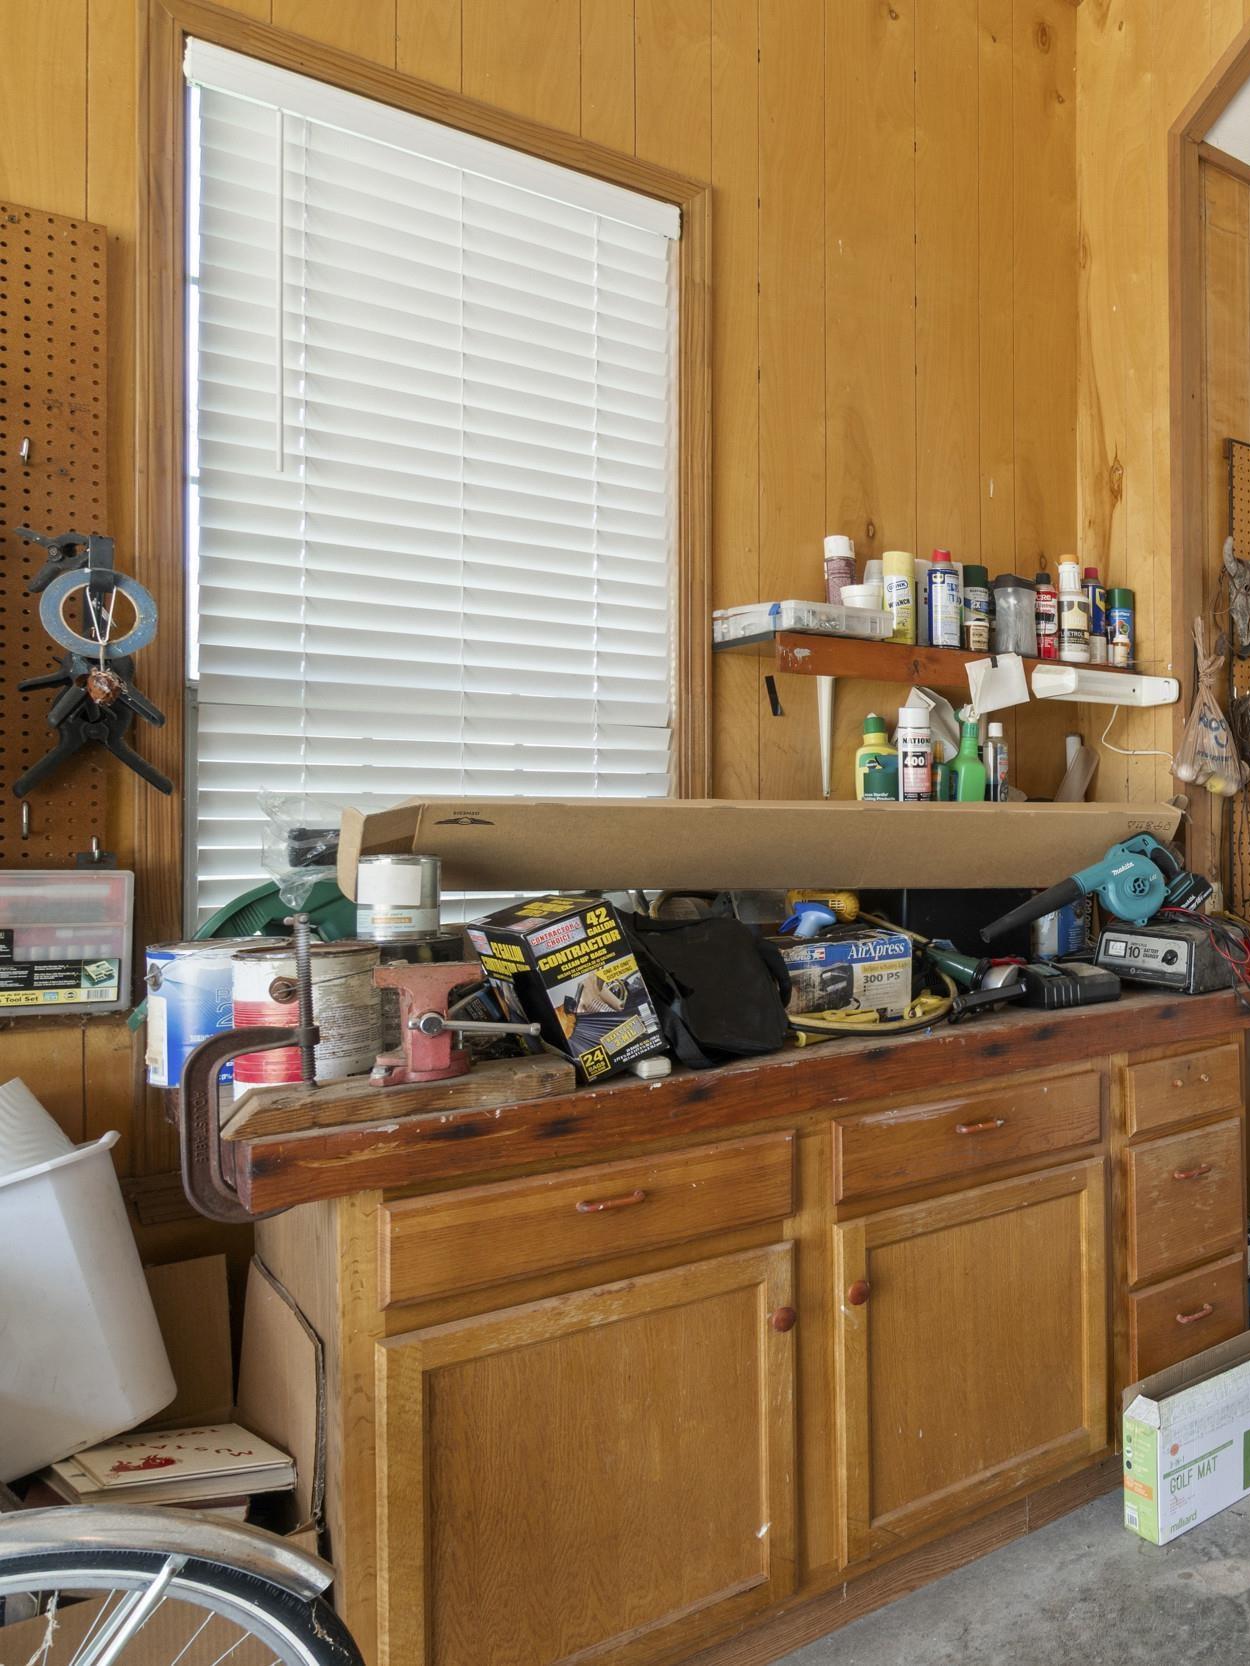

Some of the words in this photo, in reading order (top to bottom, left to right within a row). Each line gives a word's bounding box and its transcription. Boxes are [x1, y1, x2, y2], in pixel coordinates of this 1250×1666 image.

[887, 598, 911, 608] WENCH
[904, 756, 925, 767] 400
[1111, 861, 1135, 876] Makita
[586, 907, 610, 925] 42
[586, 919, 616, 937] GALLON
[537, 929, 621, 972] CONTRACTOR
[847, 941, 905, 961] AirXpress
[1128, 945, 1141, 959] 10
[863, 974, 884, 984] 300
[583, 1049, 604, 1067] 24
[588, 1060, 606, 1073] BAGS
[1169, 1468, 1193, 1494] GOLF
[1197, 1455, 1218, 1481] MAT
[1170, 1509, 1198, 1534] milliard
